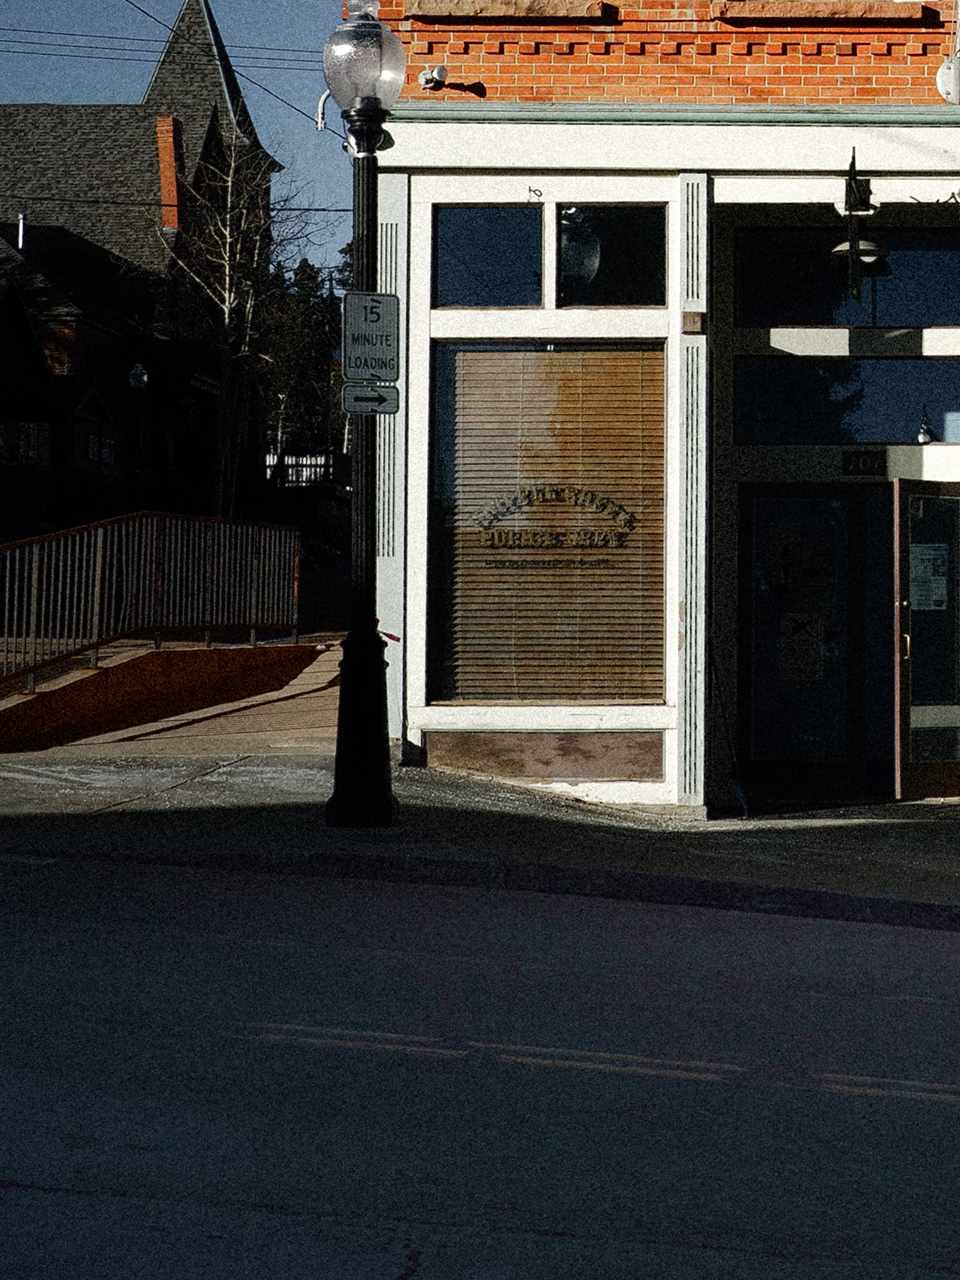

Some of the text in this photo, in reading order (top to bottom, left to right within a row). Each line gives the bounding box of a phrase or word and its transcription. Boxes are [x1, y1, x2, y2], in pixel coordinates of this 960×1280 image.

[363, 305, 381, 323] 15
[352, 334, 392, 347] MINUTE
[348, 357, 395, 370] LOADING
